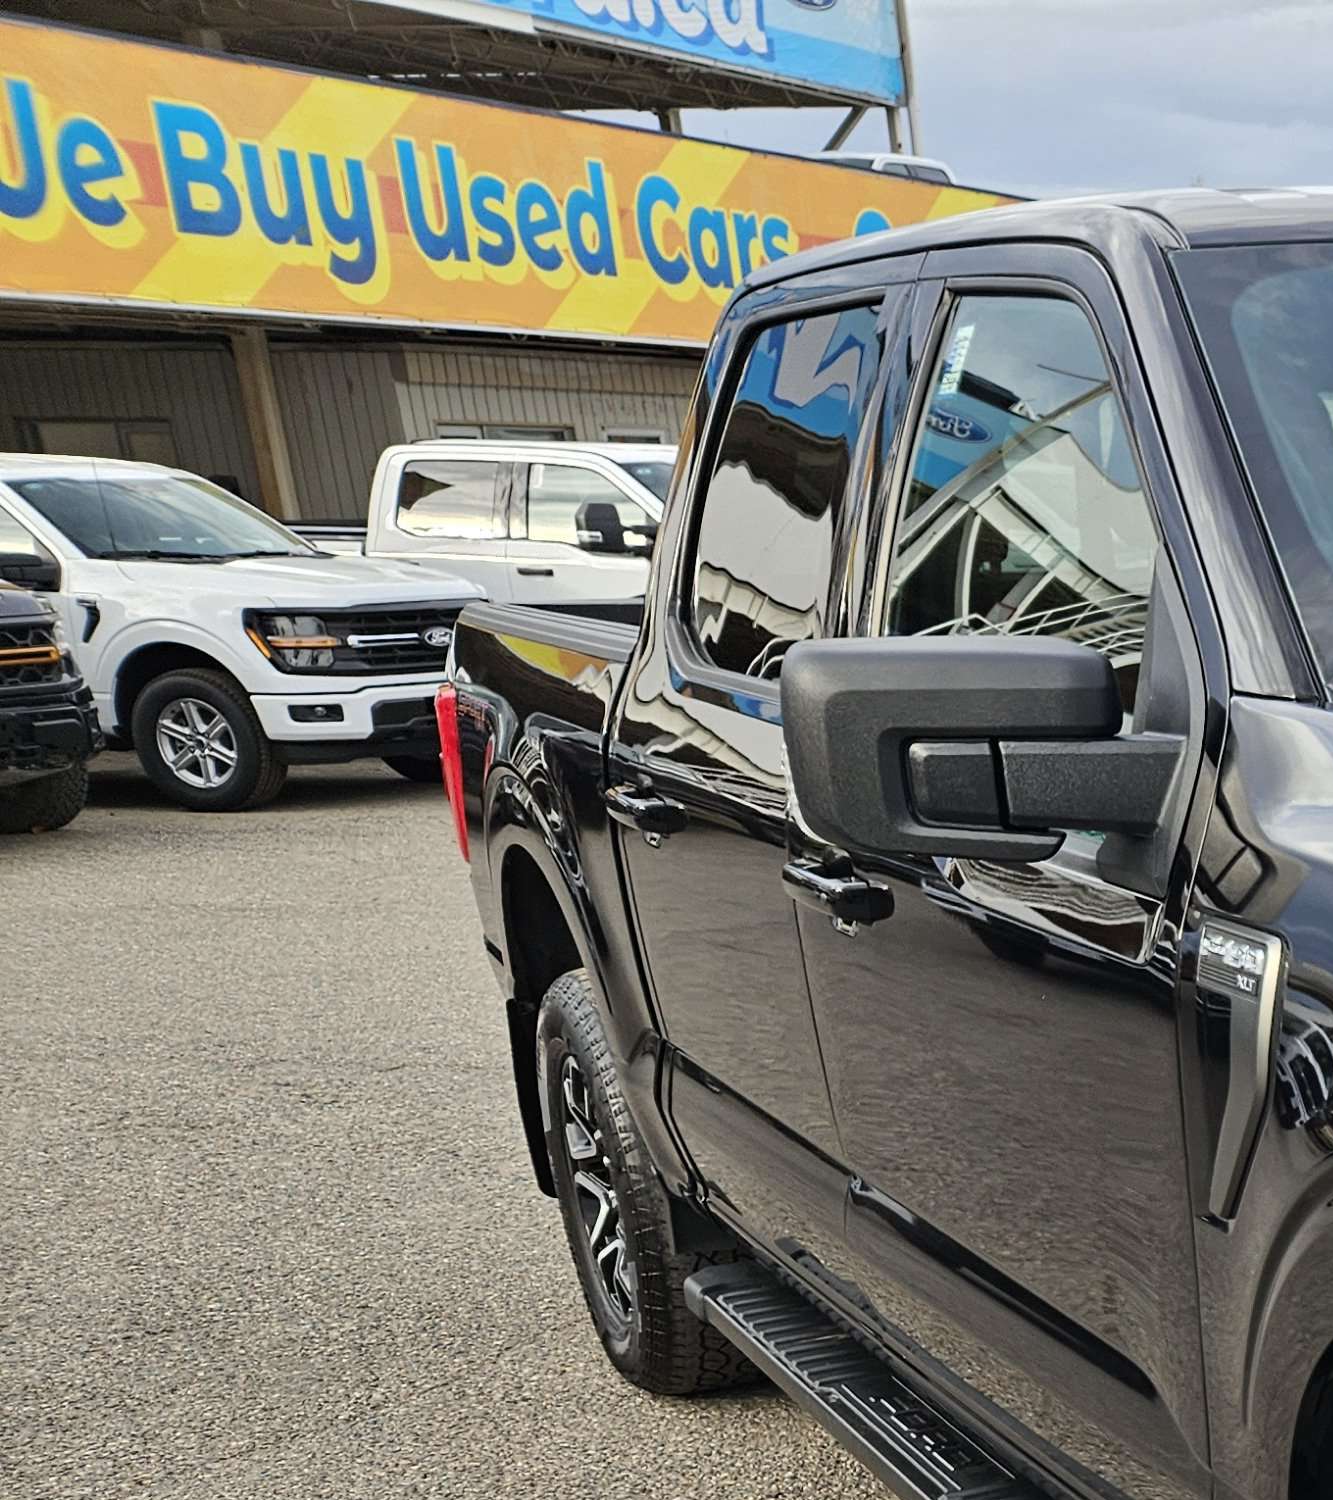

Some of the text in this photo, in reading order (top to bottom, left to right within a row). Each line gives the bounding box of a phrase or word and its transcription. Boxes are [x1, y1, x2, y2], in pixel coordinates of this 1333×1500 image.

[152, 101, 376, 285] Buy
[394, 136, 618, 276] Used
[637, 174, 791, 289] Cars
[1236, 974, 1257, 992] XLT
